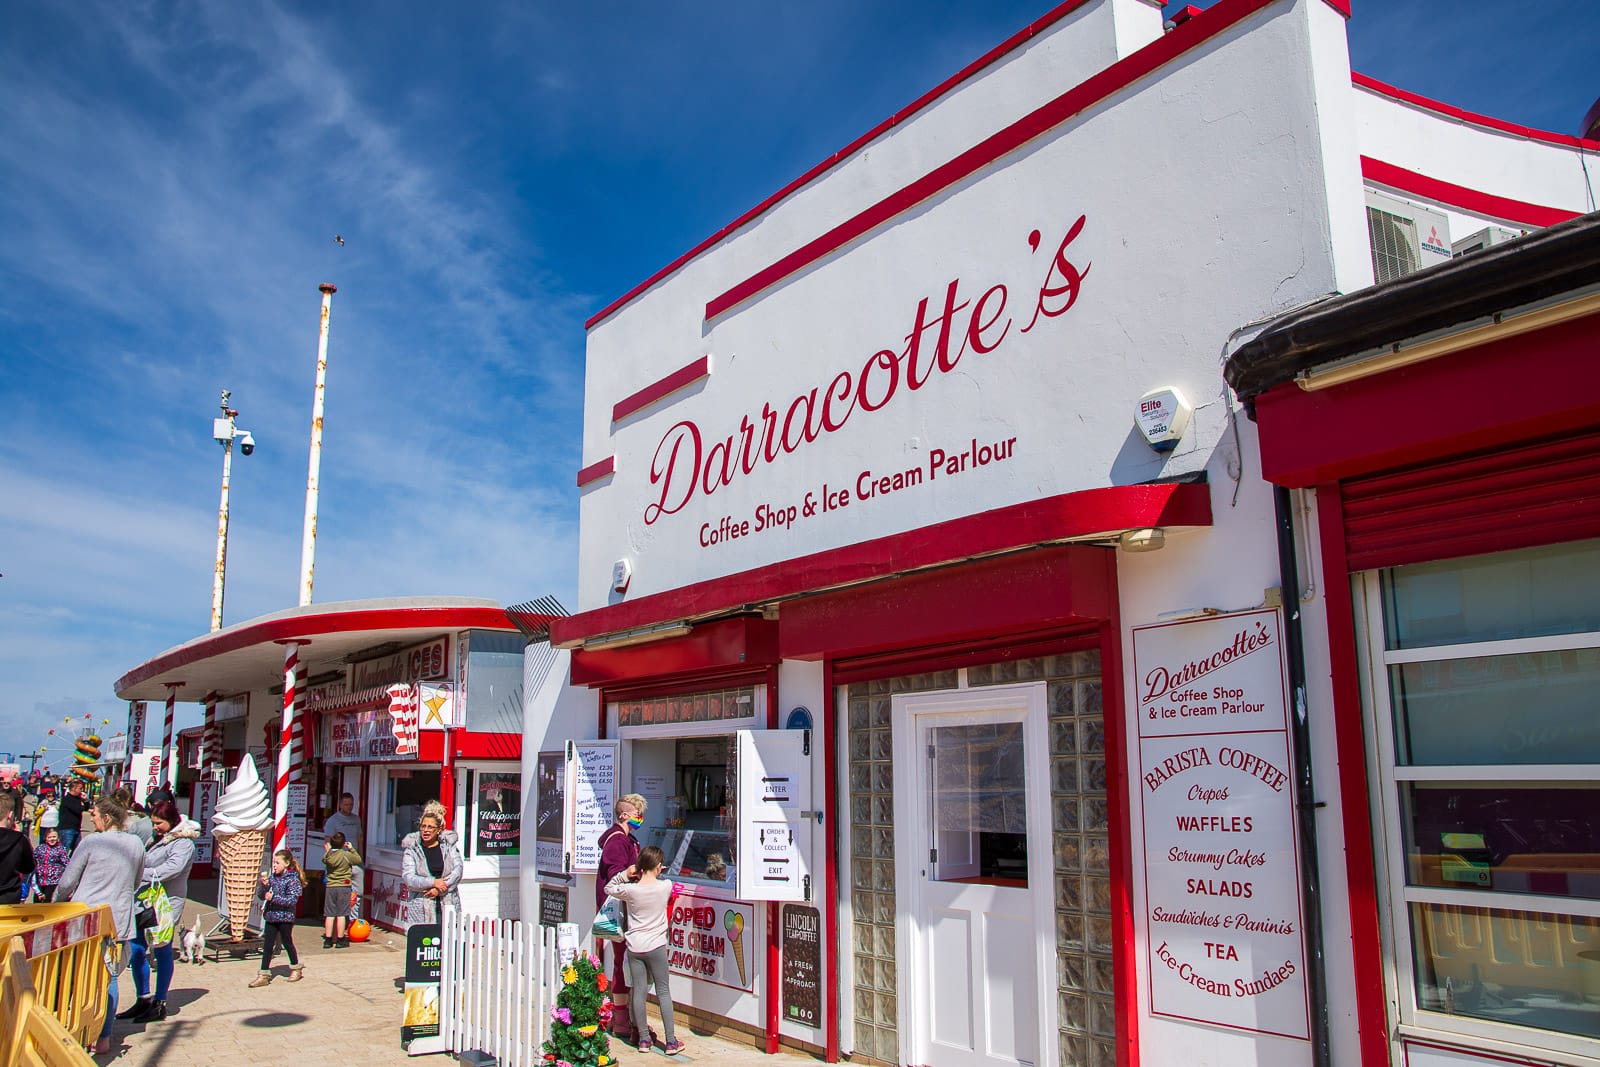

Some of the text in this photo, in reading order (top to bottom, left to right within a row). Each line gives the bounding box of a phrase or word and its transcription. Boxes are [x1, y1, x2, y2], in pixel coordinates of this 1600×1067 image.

[644, 213, 1092, 526] Darracotte's
[1141, 400, 1162, 413] Elite
[699, 437, 1017, 549] Coffee Shop & Ice Cream Parlour
[405, 643, 443, 682] ICES
[1142, 621, 1270, 703] Darracotte's
[1170, 687, 1244, 703] Coffee Shop
[1149, 701, 1265, 719] & Ice Cream Parlour
[133, 703, 143, 752] HOT DOGS
[1143, 747, 1288, 793] BARISTA COFFEE
[1187, 784, 1230, 804] Crepes
[199, 783, 213, 837] WAFFLES
[480, 810, 520, 822] Whipped
[1176, 815, 1253, 832] WAFFLES
[1168, 846, 1266, 870] Scrummy Cakes
[1187, 878, 1253, 898] SALADS
[672, 905, 717, 932] OPED
[786, 913, 817, 932] LINCOLN
[1152, 906, 1295, 935] Sandwiches & Paninis
[668, 928, 725, 957] ICE CREAM
[1203, 941, 1239, 962] TEA
[667, 949, 717, 976] LAVOURS
[794, 960, 814, 971] FRESH
[786, 976, 817, 988] APPROACH
[1234, 959, 1296, 997] Sundaes
